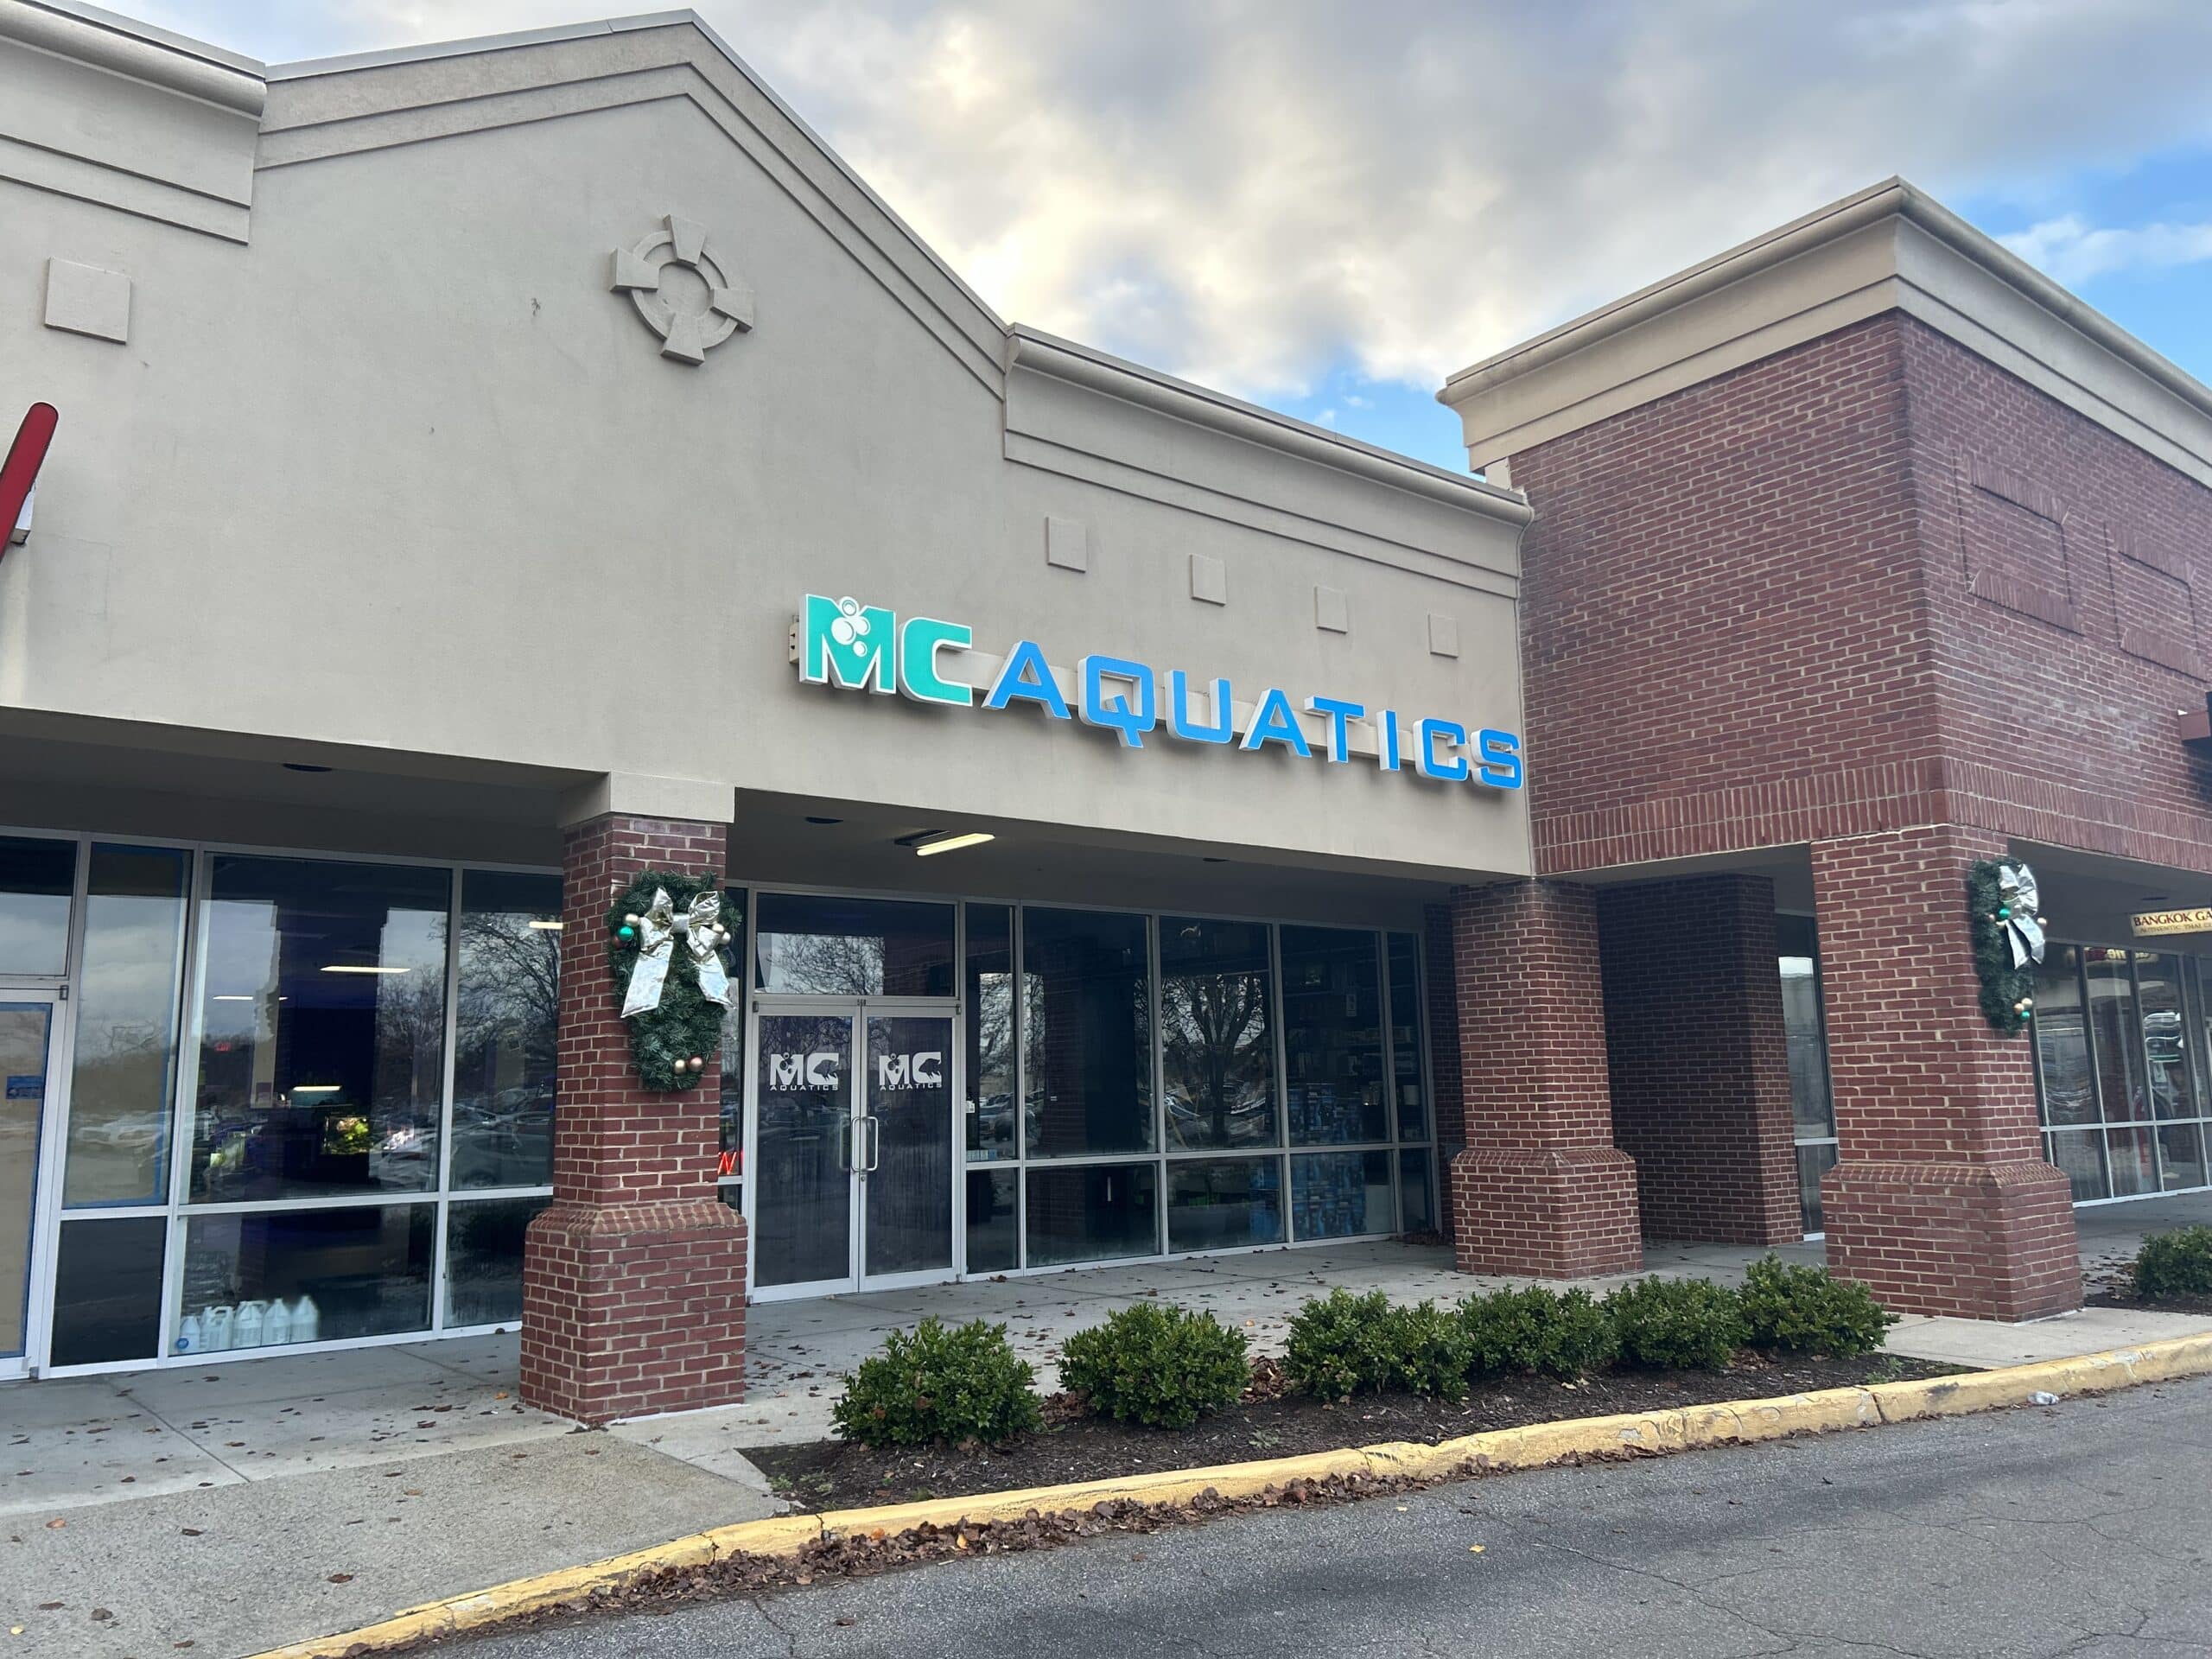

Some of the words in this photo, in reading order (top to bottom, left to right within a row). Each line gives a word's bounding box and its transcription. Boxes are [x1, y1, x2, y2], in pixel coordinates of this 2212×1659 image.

[798, 593, 973, 707] MC
[982, 640, 1523, 790] AQUATICS
[2133, 912, 2192, 926] BANGKOK
[770, 1052, 839, 1085] MC
[879, 1051, 942, 1084] MC
[880, 1083, 942, 1091] AQUATICS
